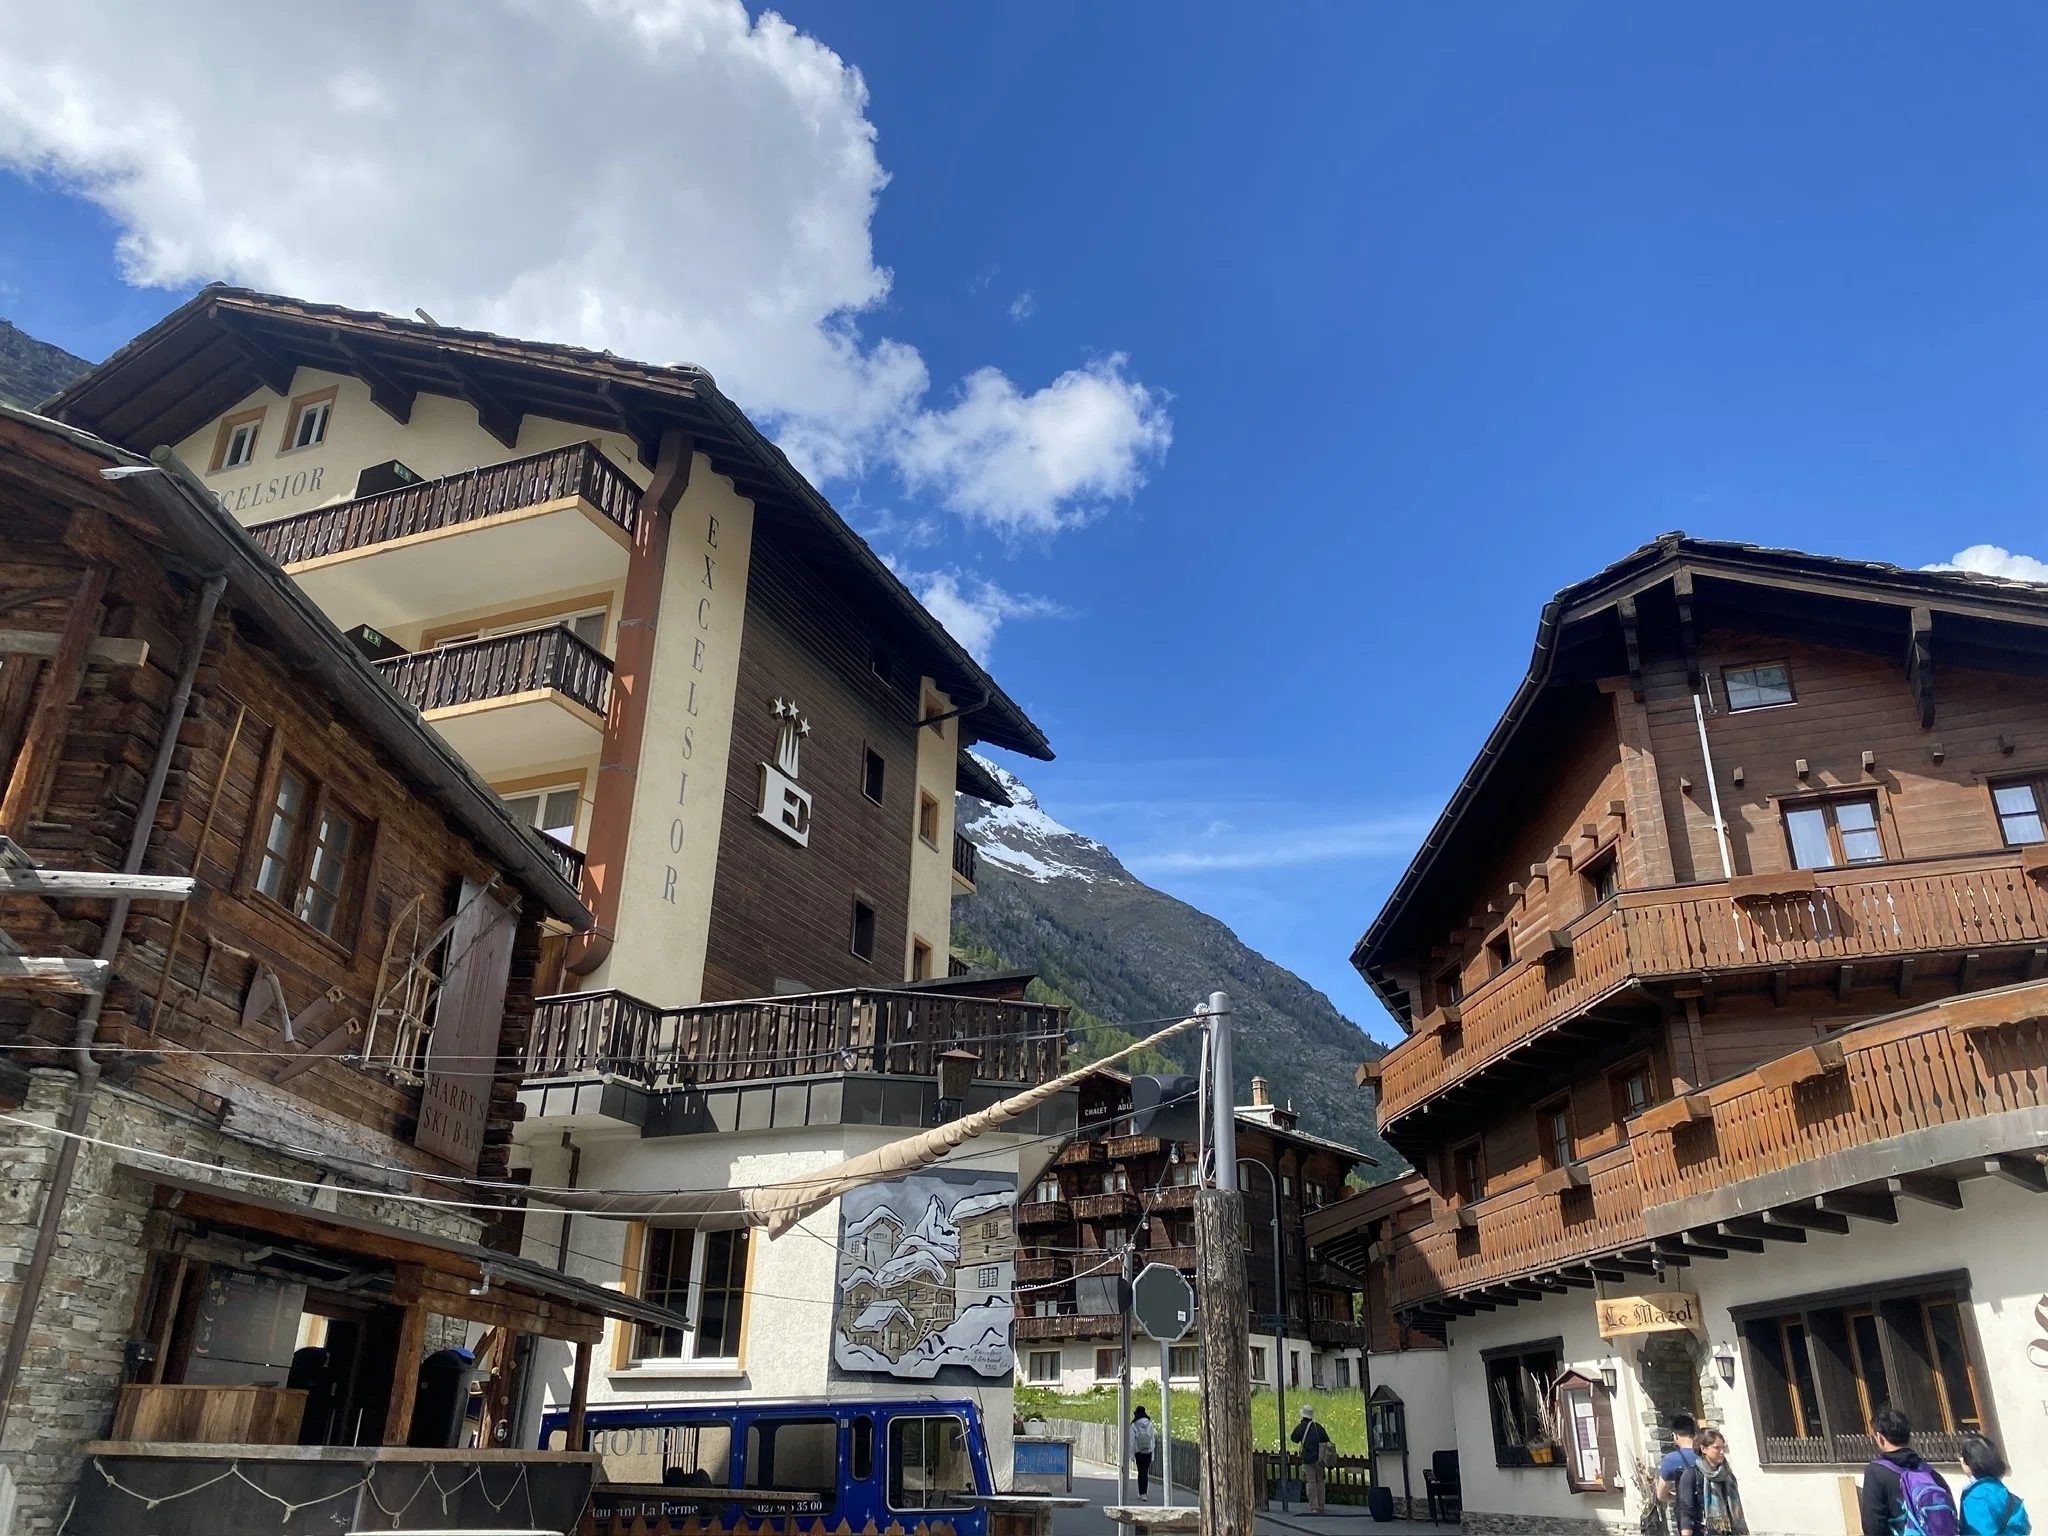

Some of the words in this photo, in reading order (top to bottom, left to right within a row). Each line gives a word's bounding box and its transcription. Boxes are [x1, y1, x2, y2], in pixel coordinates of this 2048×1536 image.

[661, 513, 720, 905] EXCELSIOR
[1084, 1106, 1108, 1117] CHALET
[422, 1106, 449, 1137] SKI
[452, 1121, 480, 1152] BAR
[1605, 1306, 1628, 1332] Le
[587, 1426, 695, 1457] HOTEL
[641, 1502, 656, 1516] La
[660, 1501, 698, 1515] Ferme
[796, 1501, 808, 1512] 35
[810, 1500, 822, 1511] 00
